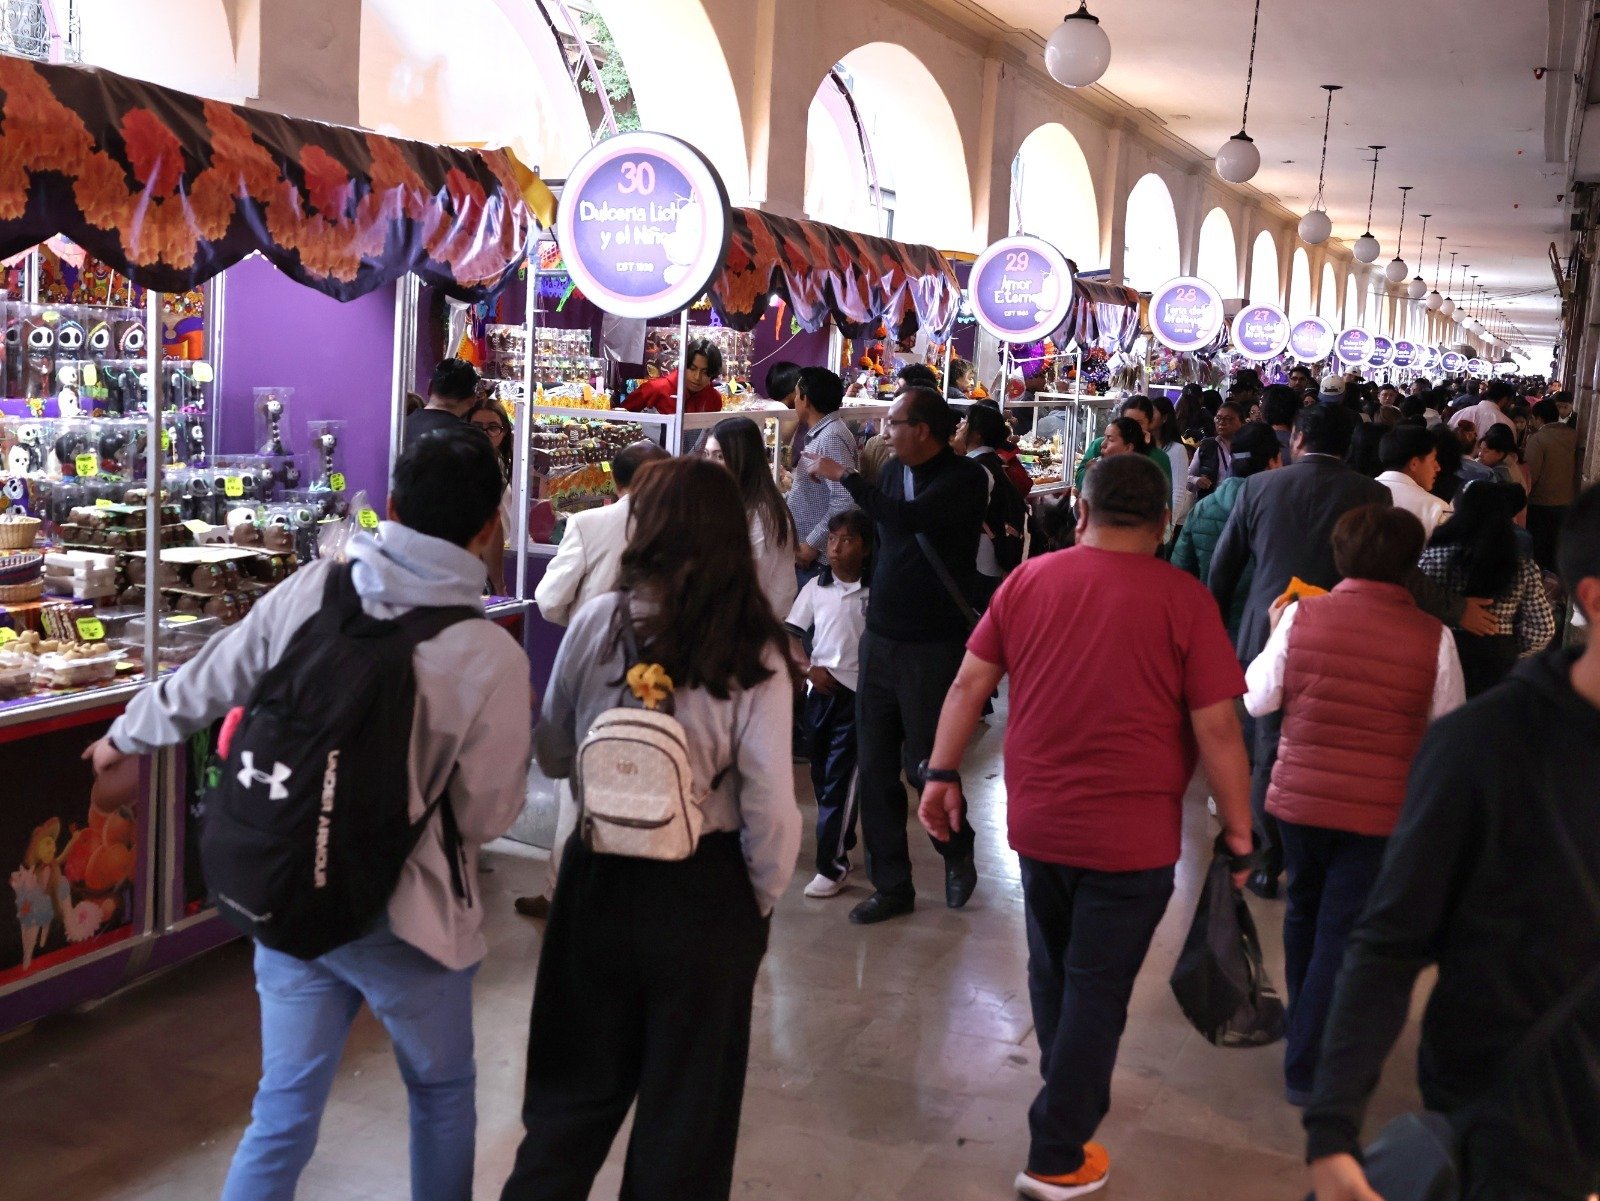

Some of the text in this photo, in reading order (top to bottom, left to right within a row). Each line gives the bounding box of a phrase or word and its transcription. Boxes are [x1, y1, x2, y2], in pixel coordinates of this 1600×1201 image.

[617, 161, 656, 195] 30
[600, 231, 612, 250] y
[615, 223, 630, 245] el
[1005, 251, 1029, 272] 29
[1001, 274, 1032, 291] Amor
[1175, 288, 1197, 302] 28
[1253, 310, 1270, 321] 27
[1304, 323, 1316, 331] 26
[1349, 331, 1360, 339] 25
